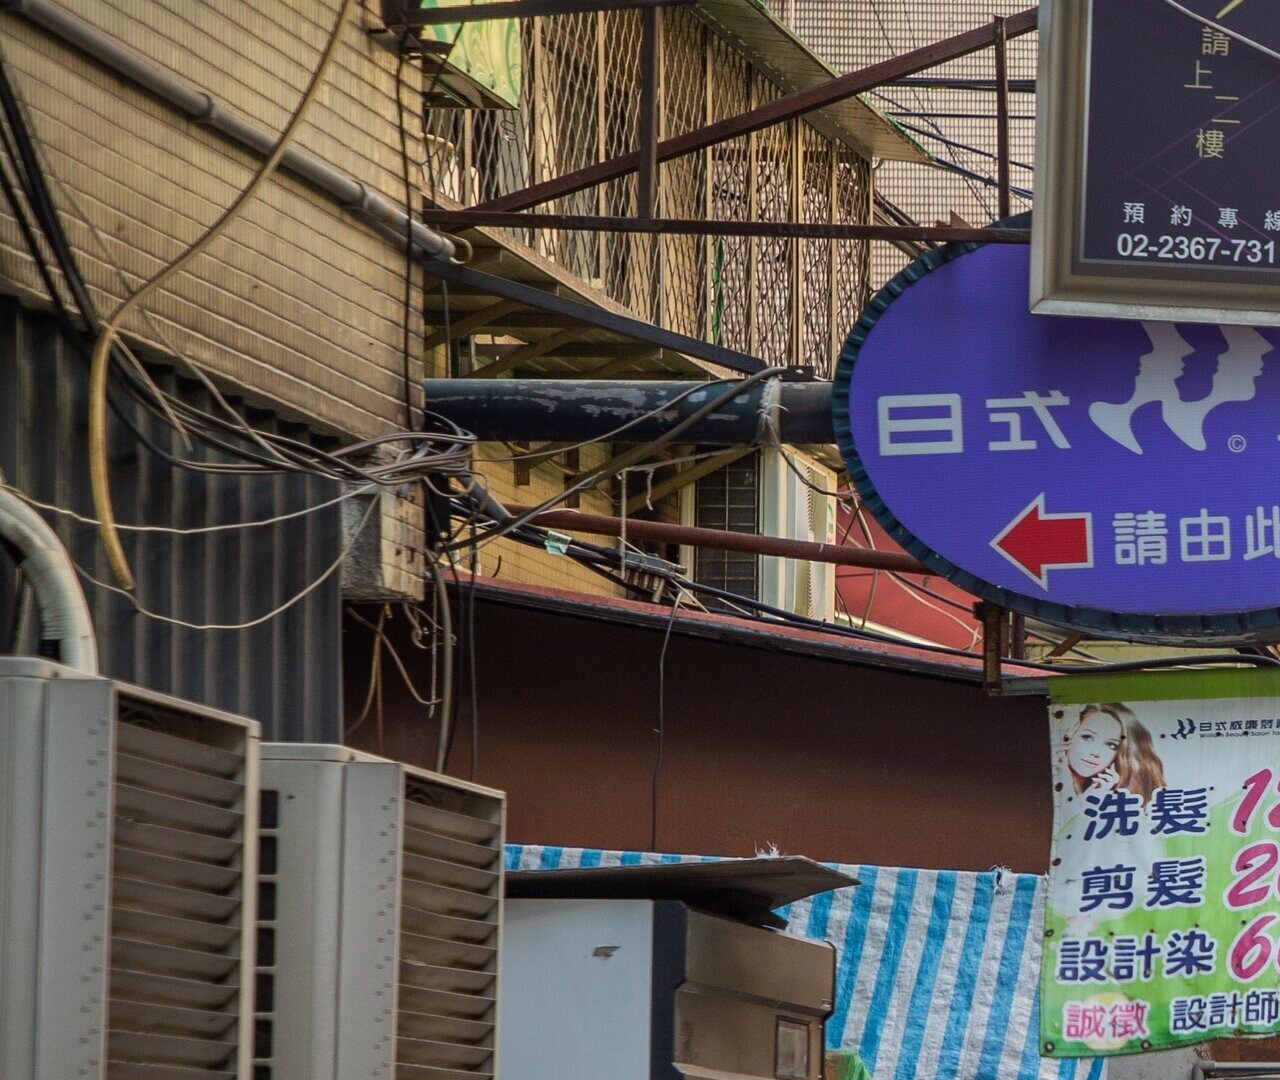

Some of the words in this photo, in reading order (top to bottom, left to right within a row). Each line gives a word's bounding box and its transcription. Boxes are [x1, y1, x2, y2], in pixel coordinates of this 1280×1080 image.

[877, 390, 1072, 457] 日式
[1082, 785, 1209, 841] 洗髮
[1078, 857, 1205, 913] 剪髮
[1058, 931, 1215, 982] 設計染
[1172, 989, 1279, 1031] 設計師
